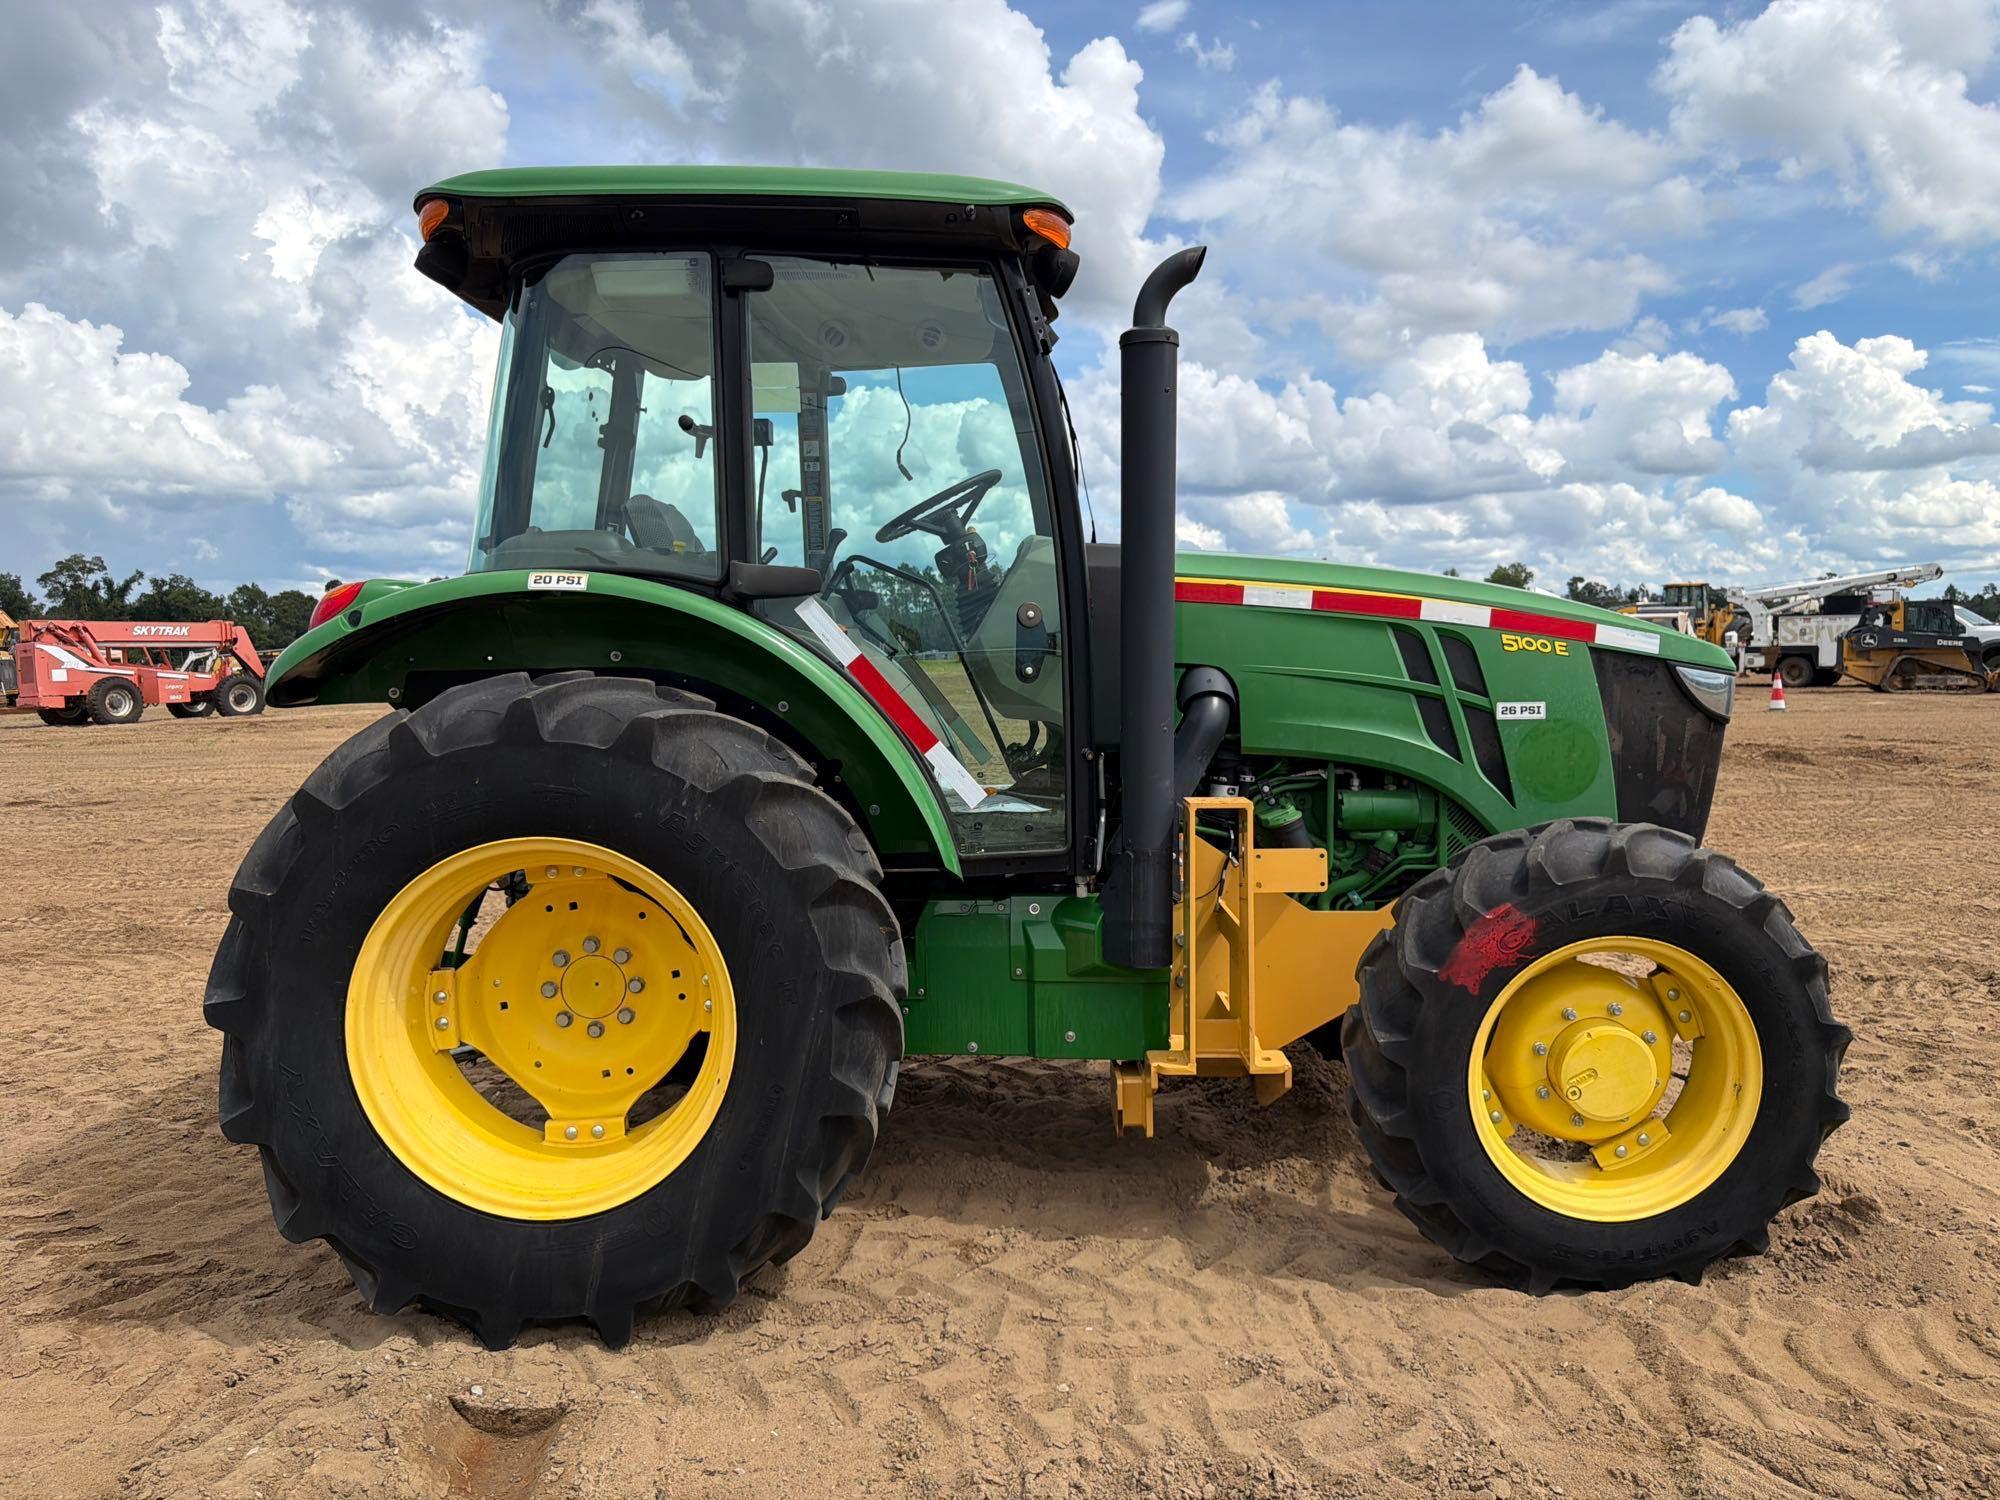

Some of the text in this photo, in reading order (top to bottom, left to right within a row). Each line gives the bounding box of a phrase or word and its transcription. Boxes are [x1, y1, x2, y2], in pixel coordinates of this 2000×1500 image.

[533, 575, 583, 585] 20 PSI
[133, 625, 191, 636] SKYTRAK
[1781, 618, 1848, 643] Serv
[1937, 639, 1964, 647] DEERE
[1501, 706, 1542, 715] 26 PSI
[1497, 893, 1712, 954] GALAXY
[279, 1062, 419, 1250] GALAXY
